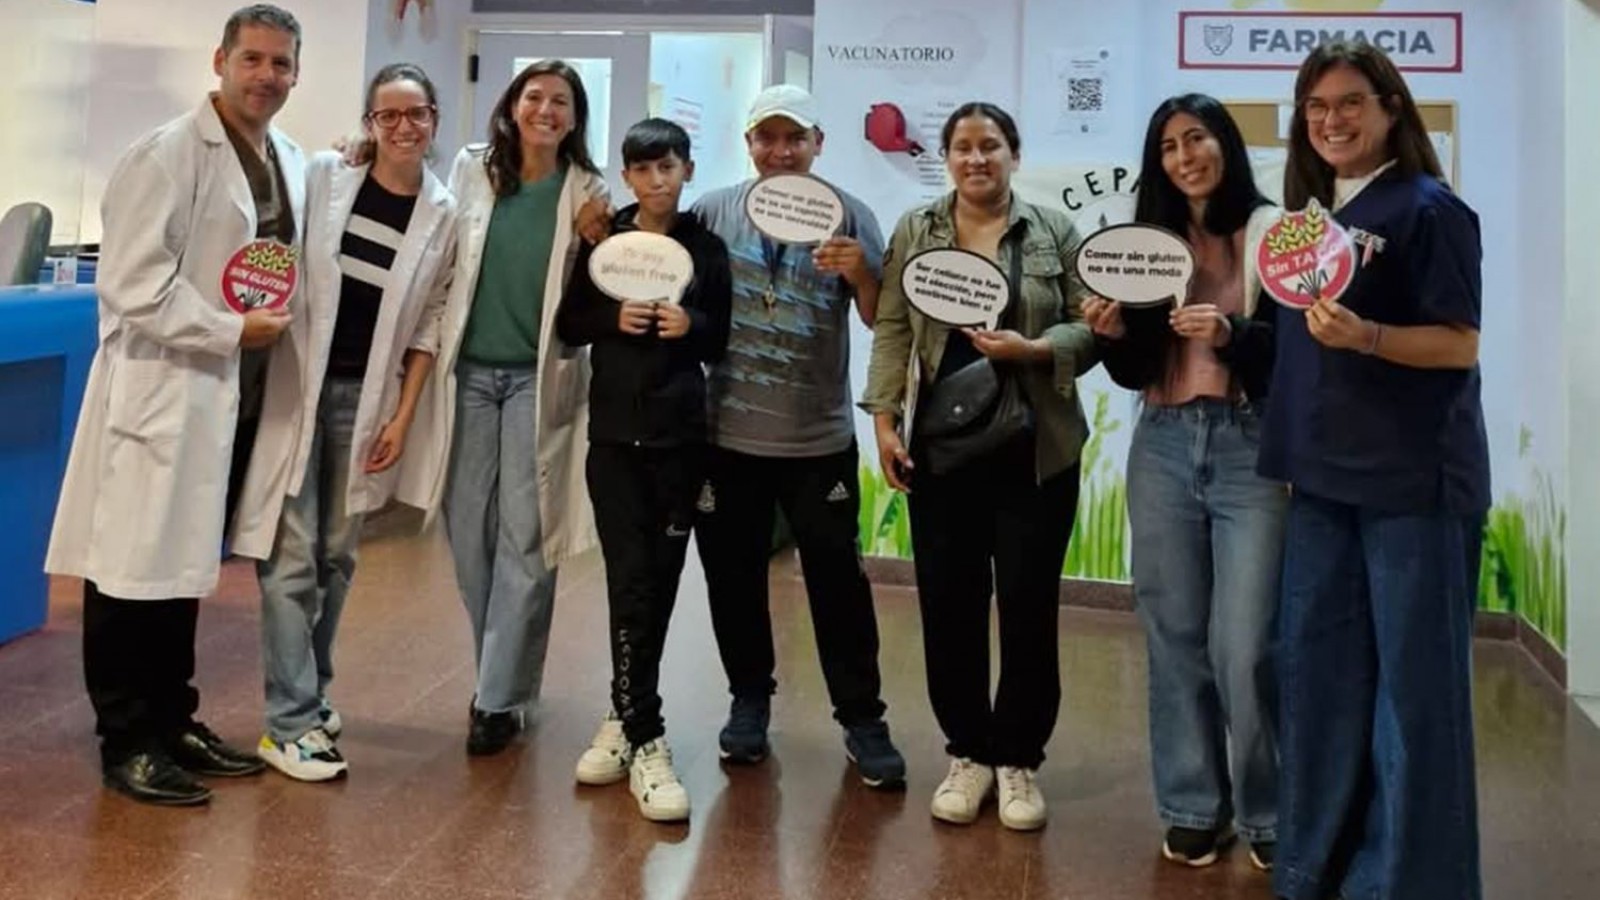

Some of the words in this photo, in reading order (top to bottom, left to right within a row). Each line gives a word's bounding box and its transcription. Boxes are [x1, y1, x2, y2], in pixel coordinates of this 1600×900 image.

[1249, 29, 1434, 54] FARMACIA
[827, 45, 954, 61] VACUNATORIO
[1084, 249, 1123, 260] Comer
[1127, 251, 1144, 261] sin
[1148, 252, 1186, 263] gluten
[1088, 265, 1103, 273] no
[1106, 266, 1119, 274] es
[1123, 266, 1146, 275] una
[1148, 267, 1183, 277] moda
[1266, 262, 1290, 277] Sin
[970, 276, 983, 285] no
[974, 291, 997, 301] pero
[959, 298, 981, 308] bien
